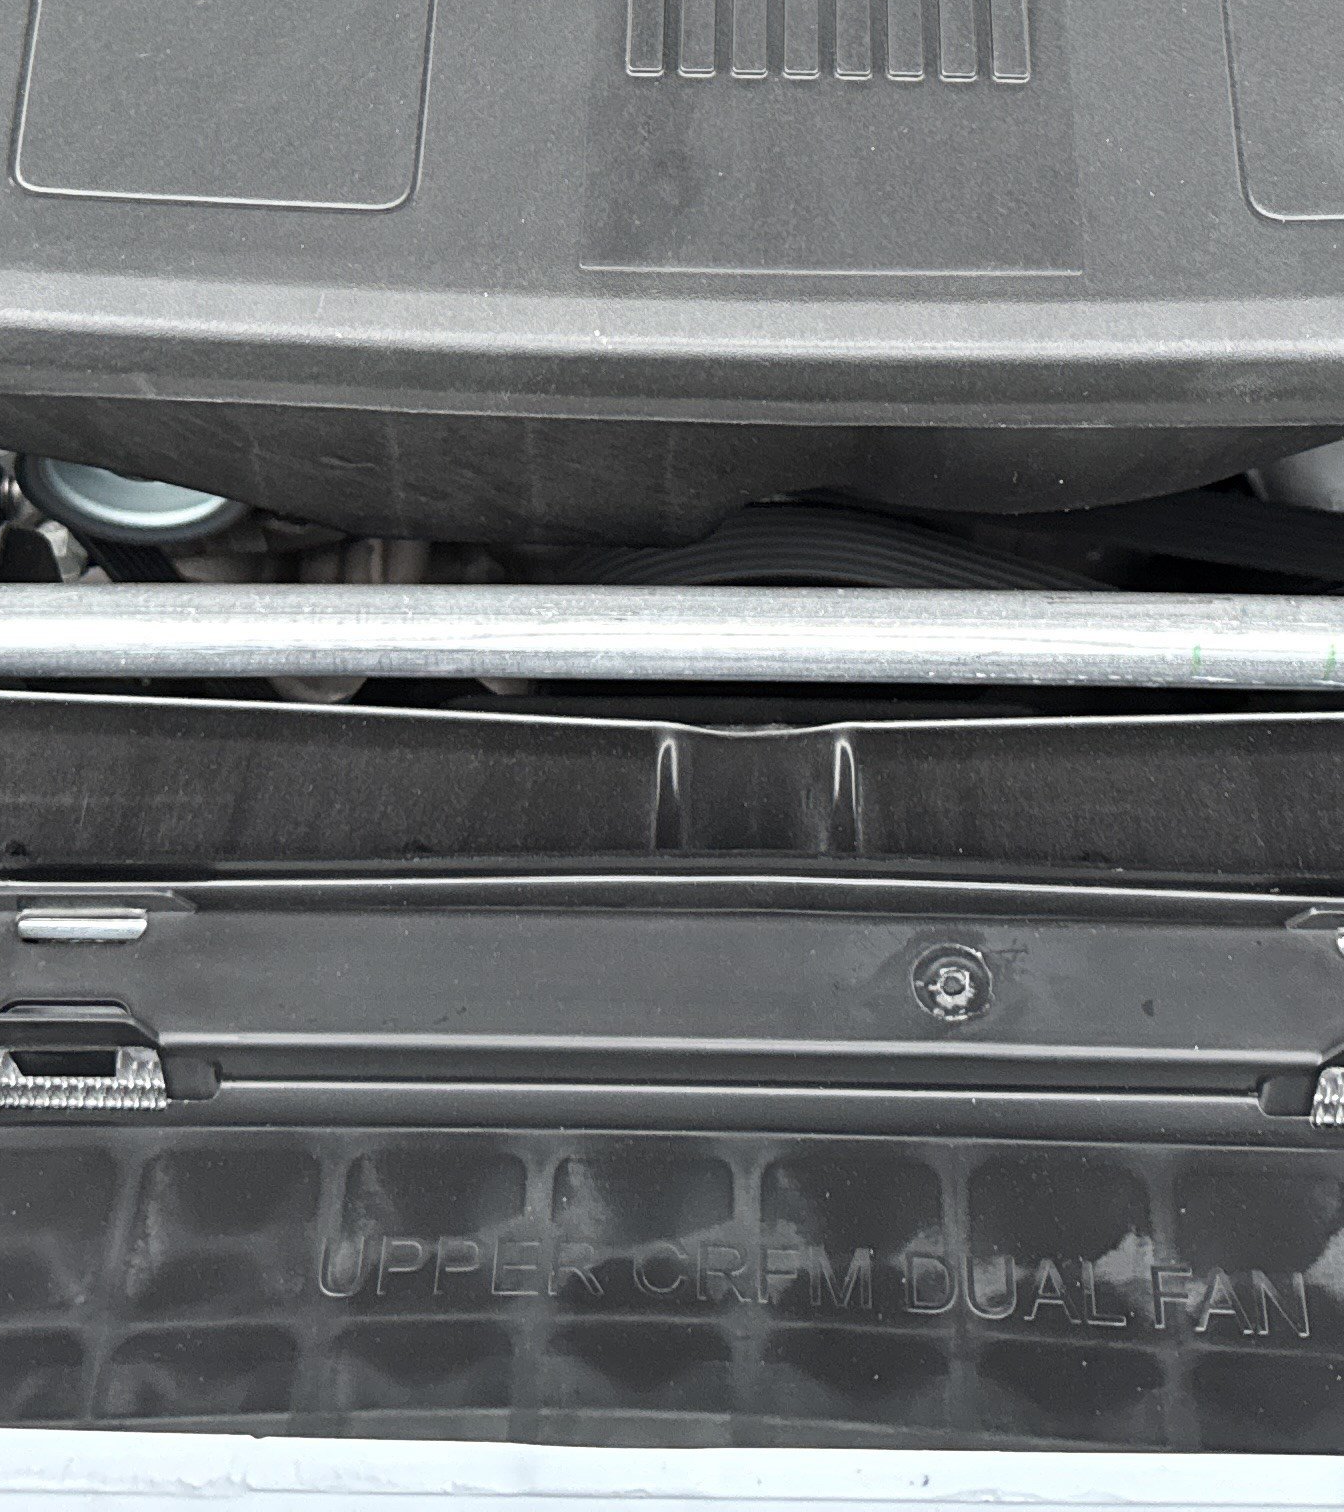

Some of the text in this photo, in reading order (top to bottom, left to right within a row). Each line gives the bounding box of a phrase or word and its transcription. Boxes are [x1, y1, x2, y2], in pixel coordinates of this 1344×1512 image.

[318, 1234, 1311, 1338] UPPER CRFM DUAL FAN
